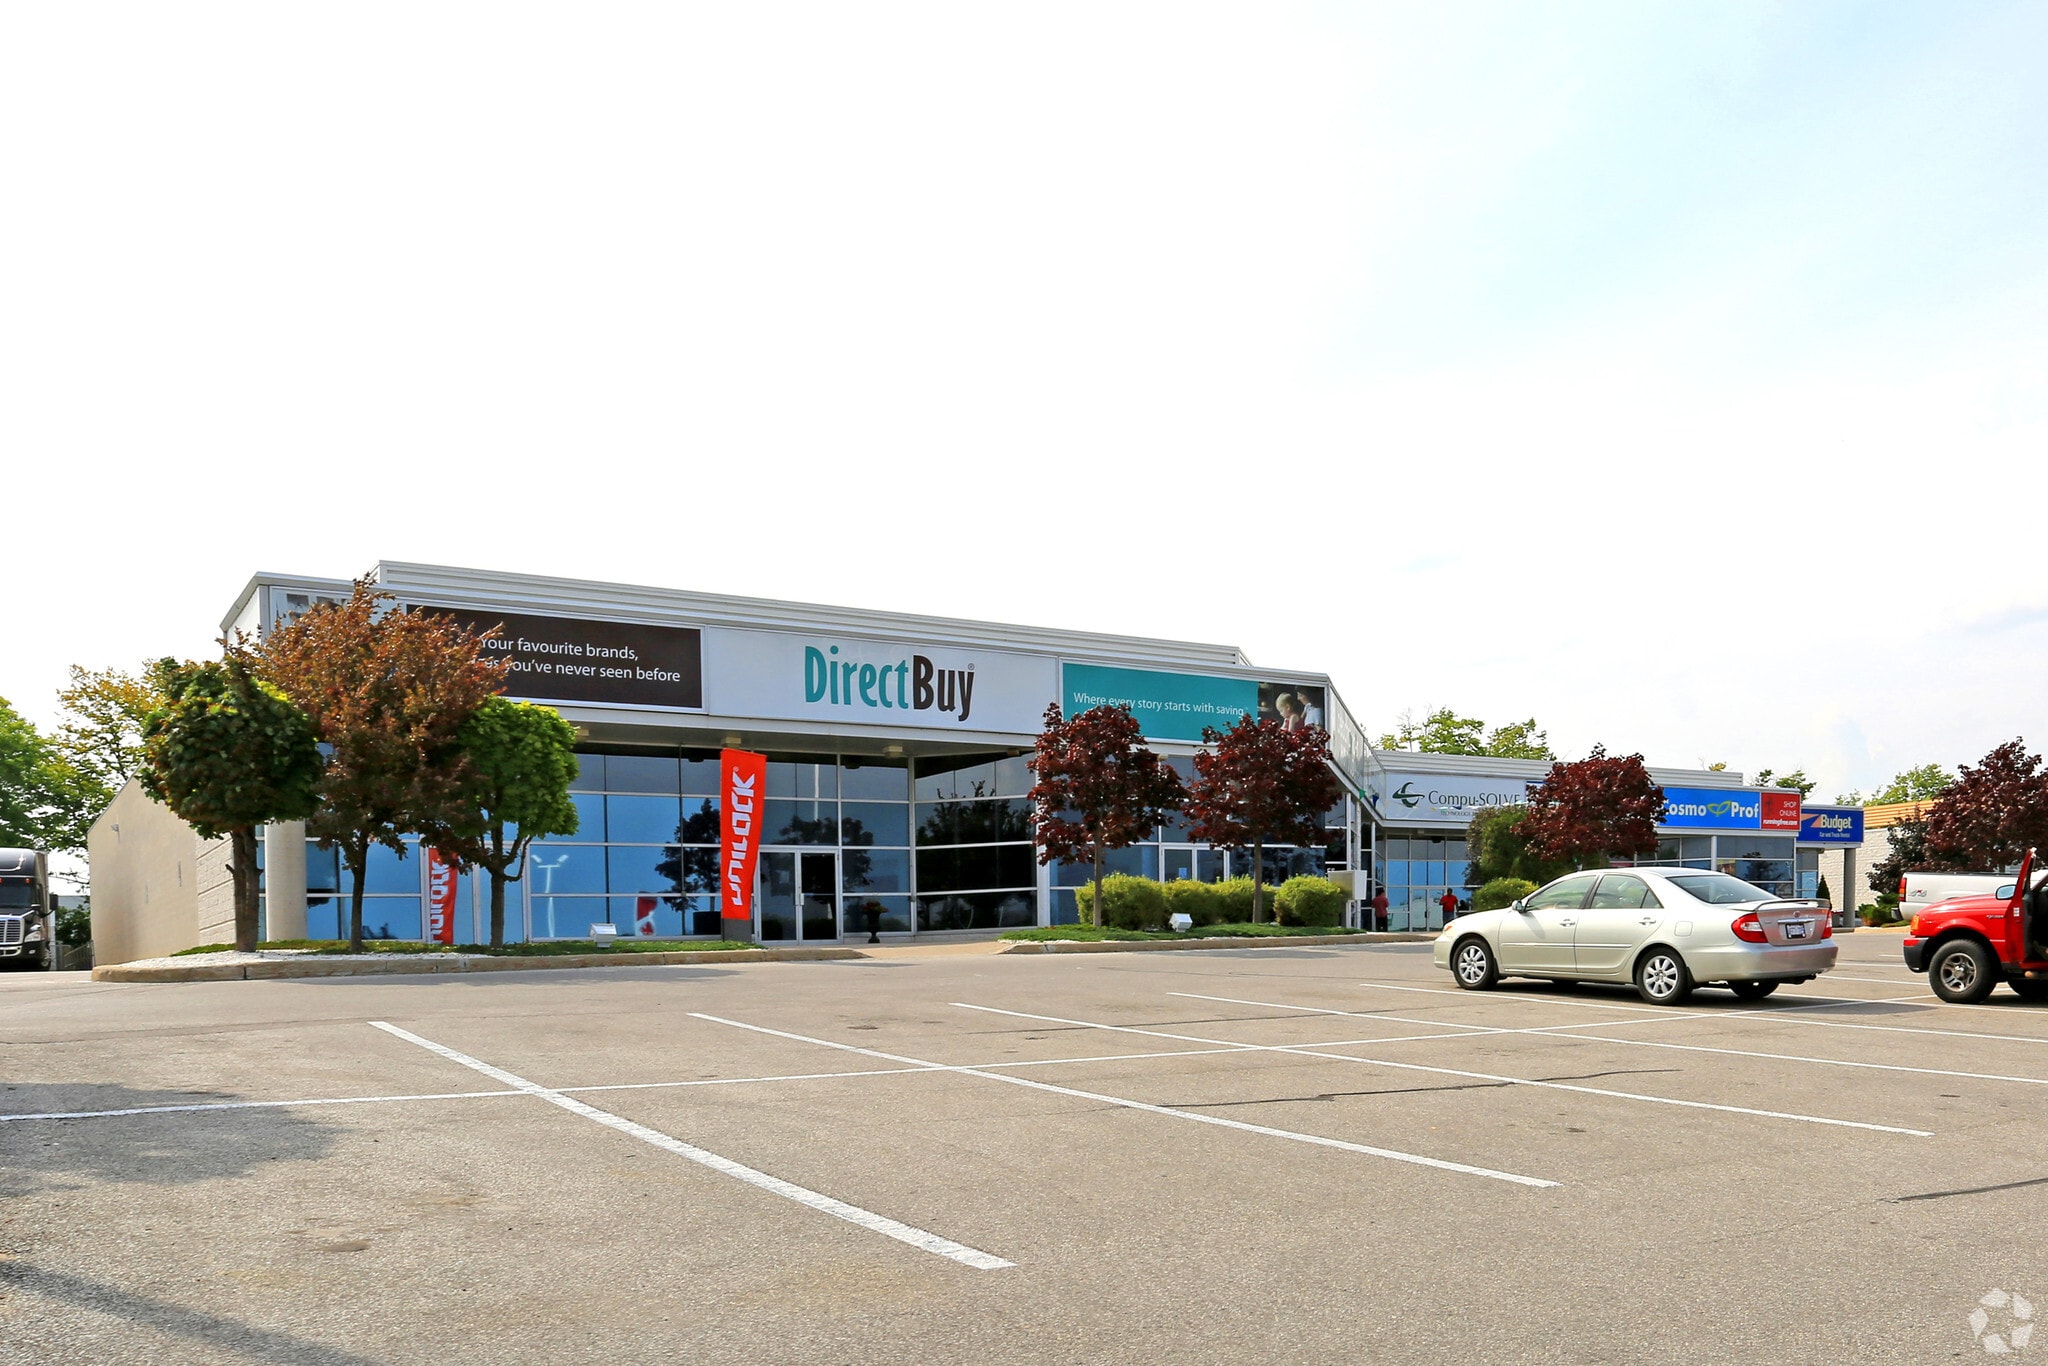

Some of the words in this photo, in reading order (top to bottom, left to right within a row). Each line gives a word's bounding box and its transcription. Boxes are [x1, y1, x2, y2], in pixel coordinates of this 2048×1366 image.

[481, 638, 514, 650] Your
[517, 638, 583, 656] favourite
[586, 643, 639, 661] brands,
[555, 663, 597, 677] never
[600, 667, 633, 679] seen
[636, 667, 681, 682] before
[805, 645, 974, 722] DirectBuy
[1073, 692, 1106, 705] Where
[1137, 699, 1163, 712] story
[1164, 701, 1191, 711] starts
[1193, 702, 1215, 713] with
[1216, 705, 1244, 719] saving
[1730, 801, 1759, 818] Prof
[1779, 809, 1797, 817] ONLINE
[1821, 814, 1853, 832] Budget
[727, 773, 756, 906] UNILOCK
